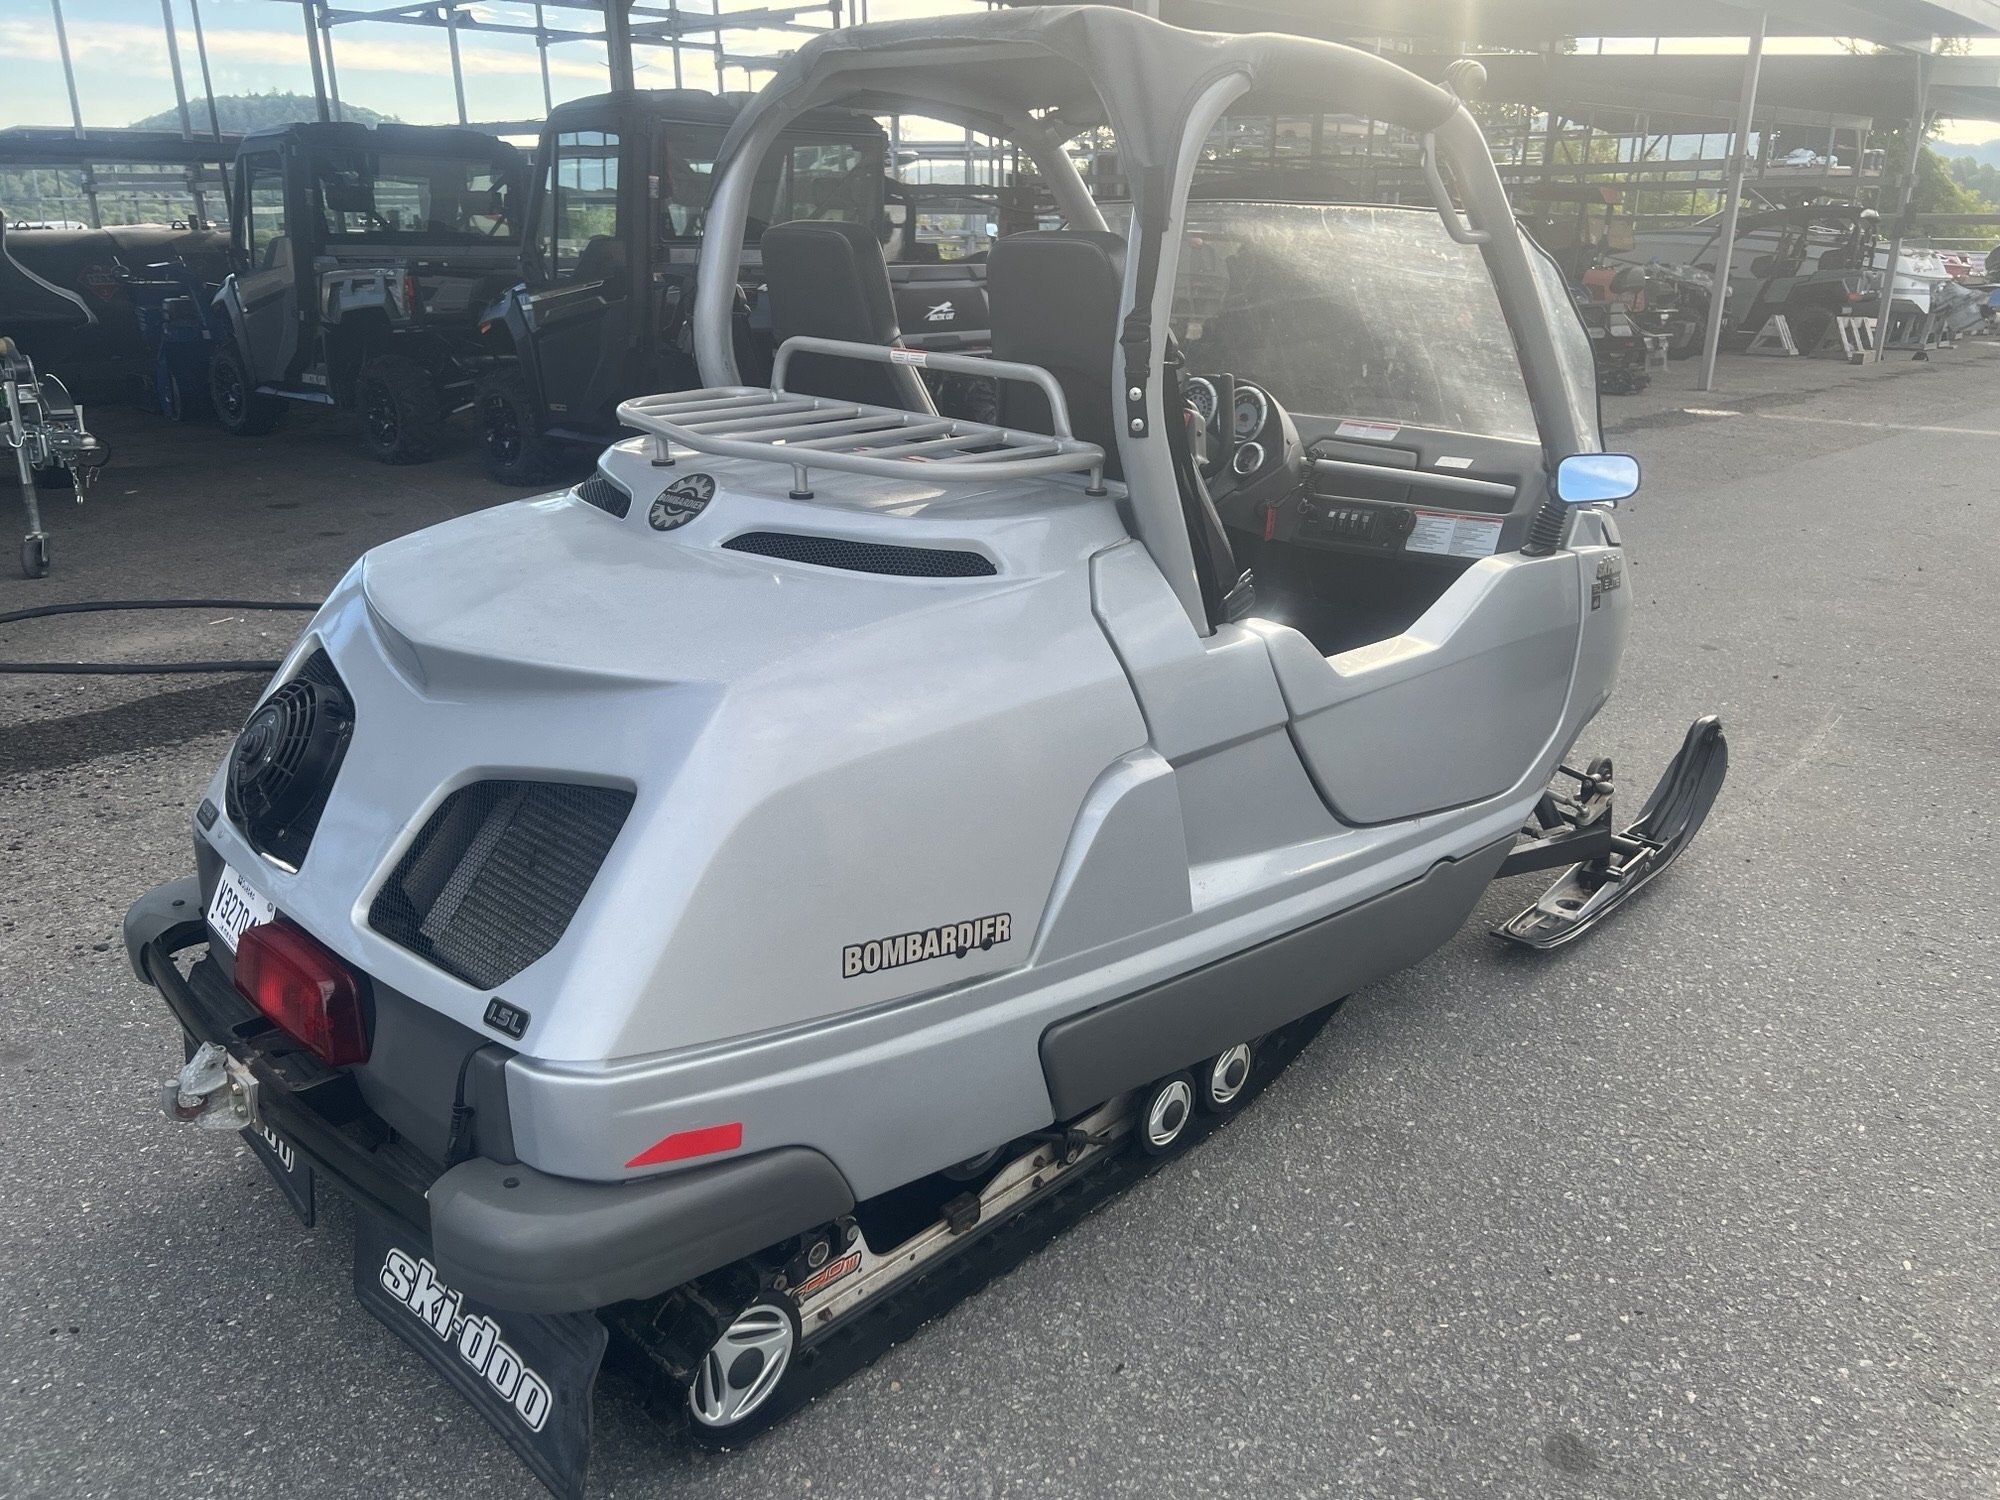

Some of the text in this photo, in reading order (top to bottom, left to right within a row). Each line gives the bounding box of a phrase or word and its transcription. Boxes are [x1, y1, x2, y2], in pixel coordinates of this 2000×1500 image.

[657, 493, 705, 511] BOMBARDIER
[843, 912, 1012, 979] BOMBARDIER
[487, 1002, 521, 1034] 1.5L
